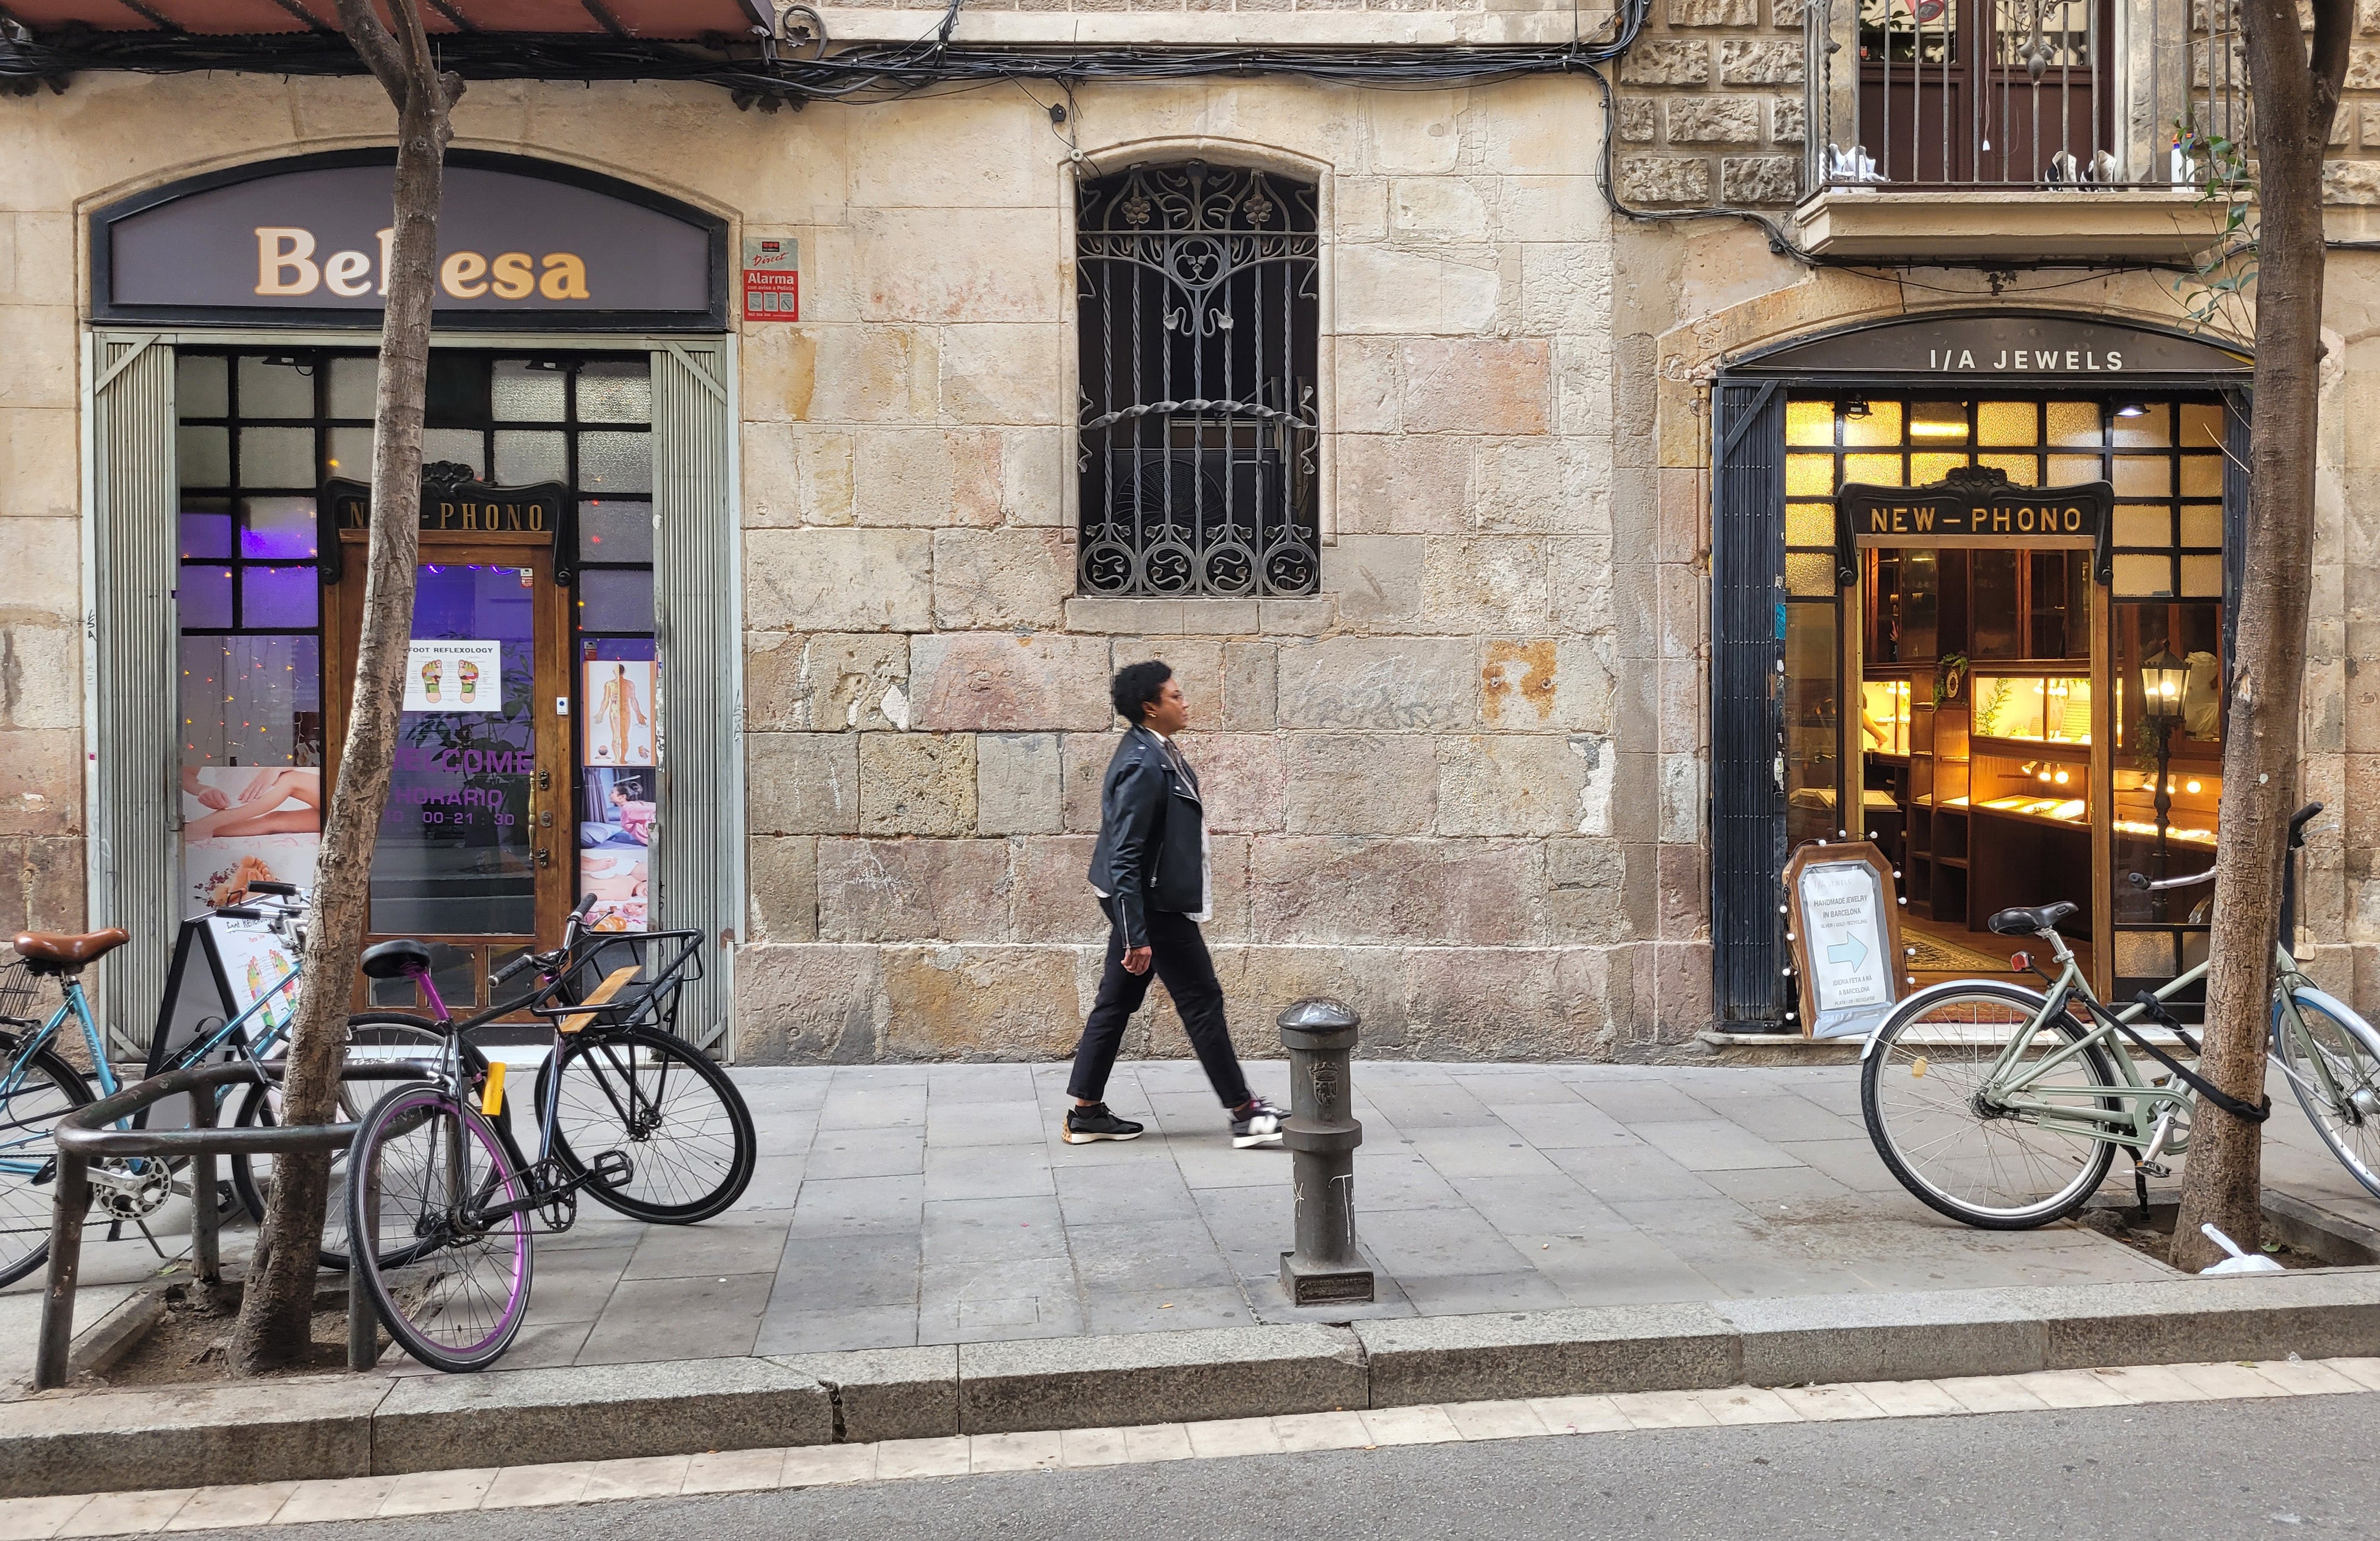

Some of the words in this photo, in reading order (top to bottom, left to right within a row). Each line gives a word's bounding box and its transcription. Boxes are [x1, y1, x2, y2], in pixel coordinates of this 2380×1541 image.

[748, 273, 794, 284] Alarma
[1930, 350, 1976, 371] I/A
[1993, 350, 2123, 370] JEWELS
[395, 787, 503, 807] HORARIO
[1813, 897, 1845, 907] HANDMADE
[1846, 894, 1868, 904] JEWELRY
[1830, 908, 1862, 918] BARCELONA
[1843, 986, 1870, 995] BARCELONA
